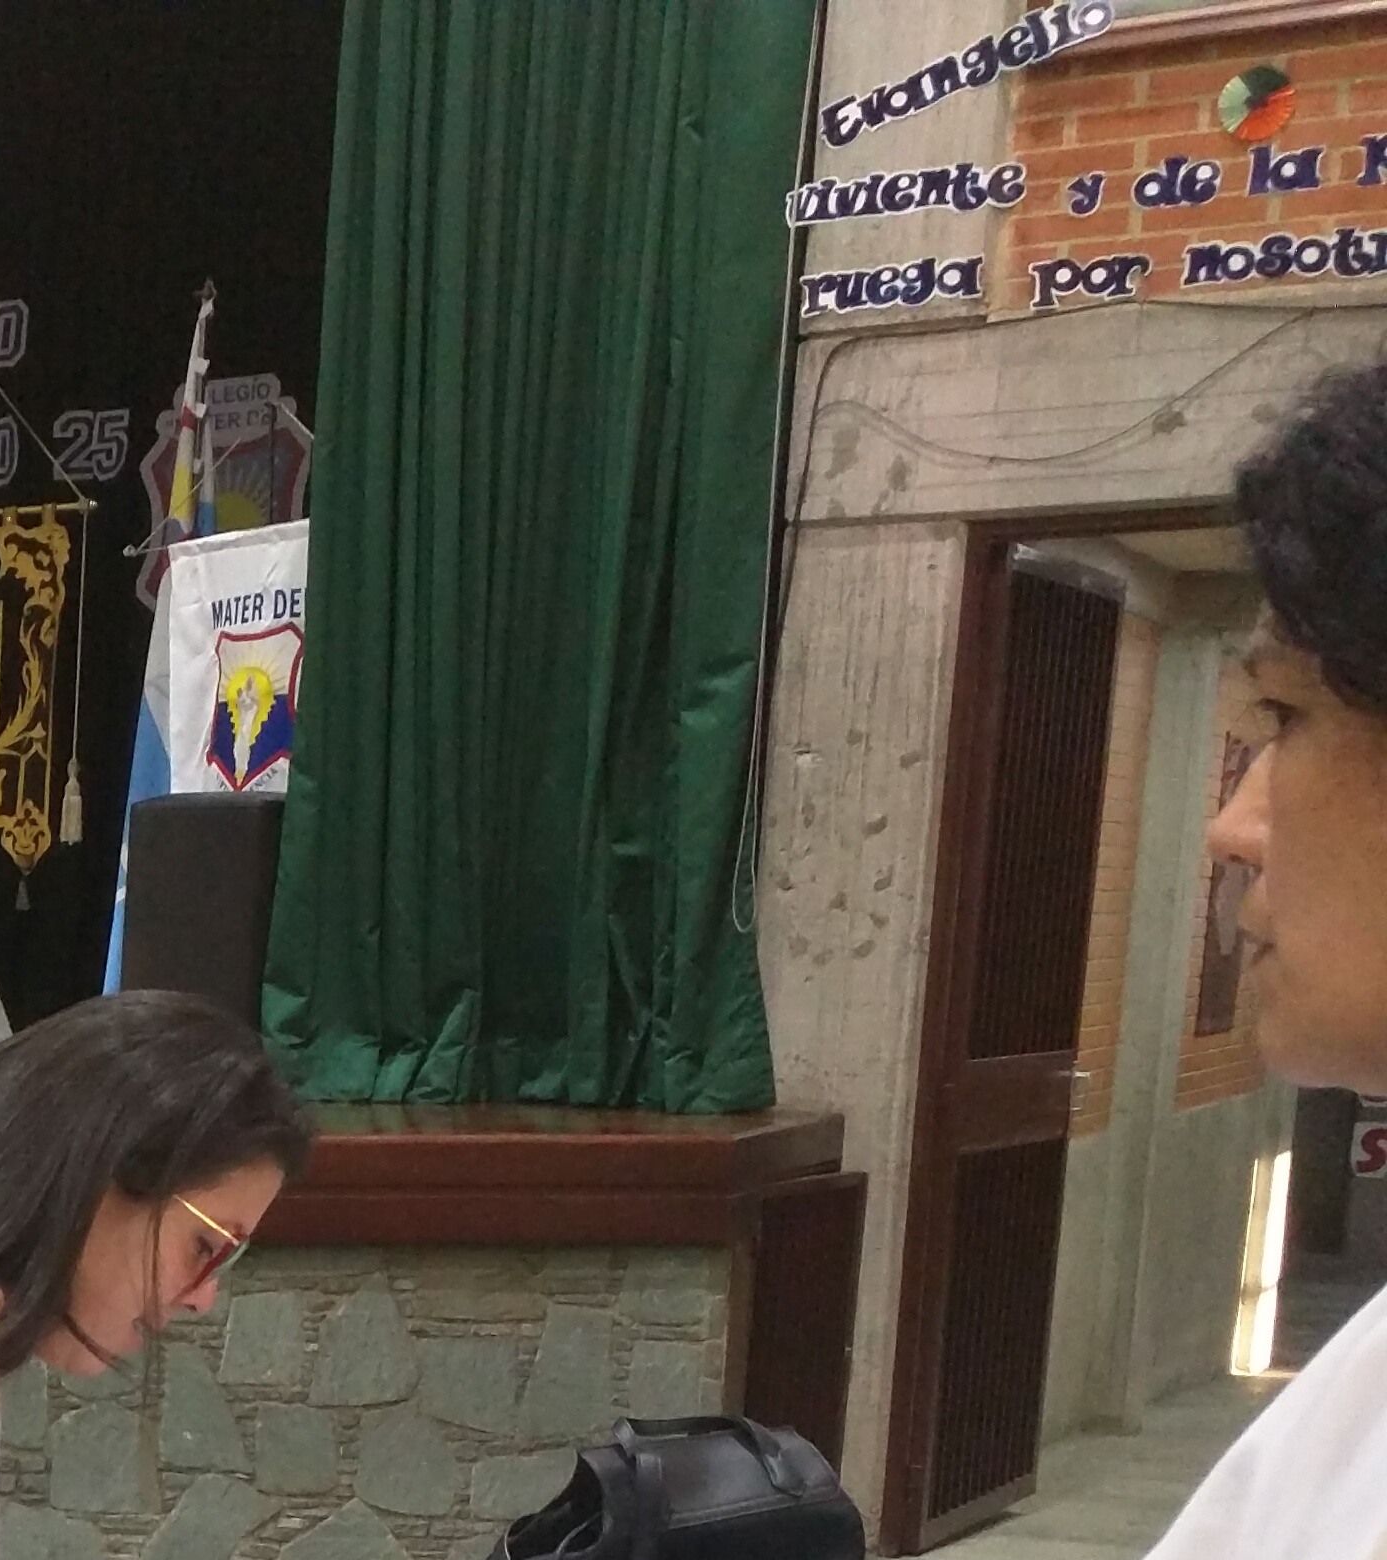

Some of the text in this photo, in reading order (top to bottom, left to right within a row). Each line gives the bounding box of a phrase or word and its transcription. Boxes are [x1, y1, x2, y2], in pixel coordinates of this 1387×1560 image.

[822, 2, 1113, 147] Evangelio
[788, 162, 1027, 224] viviente
[1066, 172, 1105, 215] y
[1134, 156, 1220, 205] de
[1248, 145, 1324, 195] la
[801, 256, 983, 315] ruega
[1030, 255, 1150, 307] por
[211, 587, 303, 631] MATER DE
